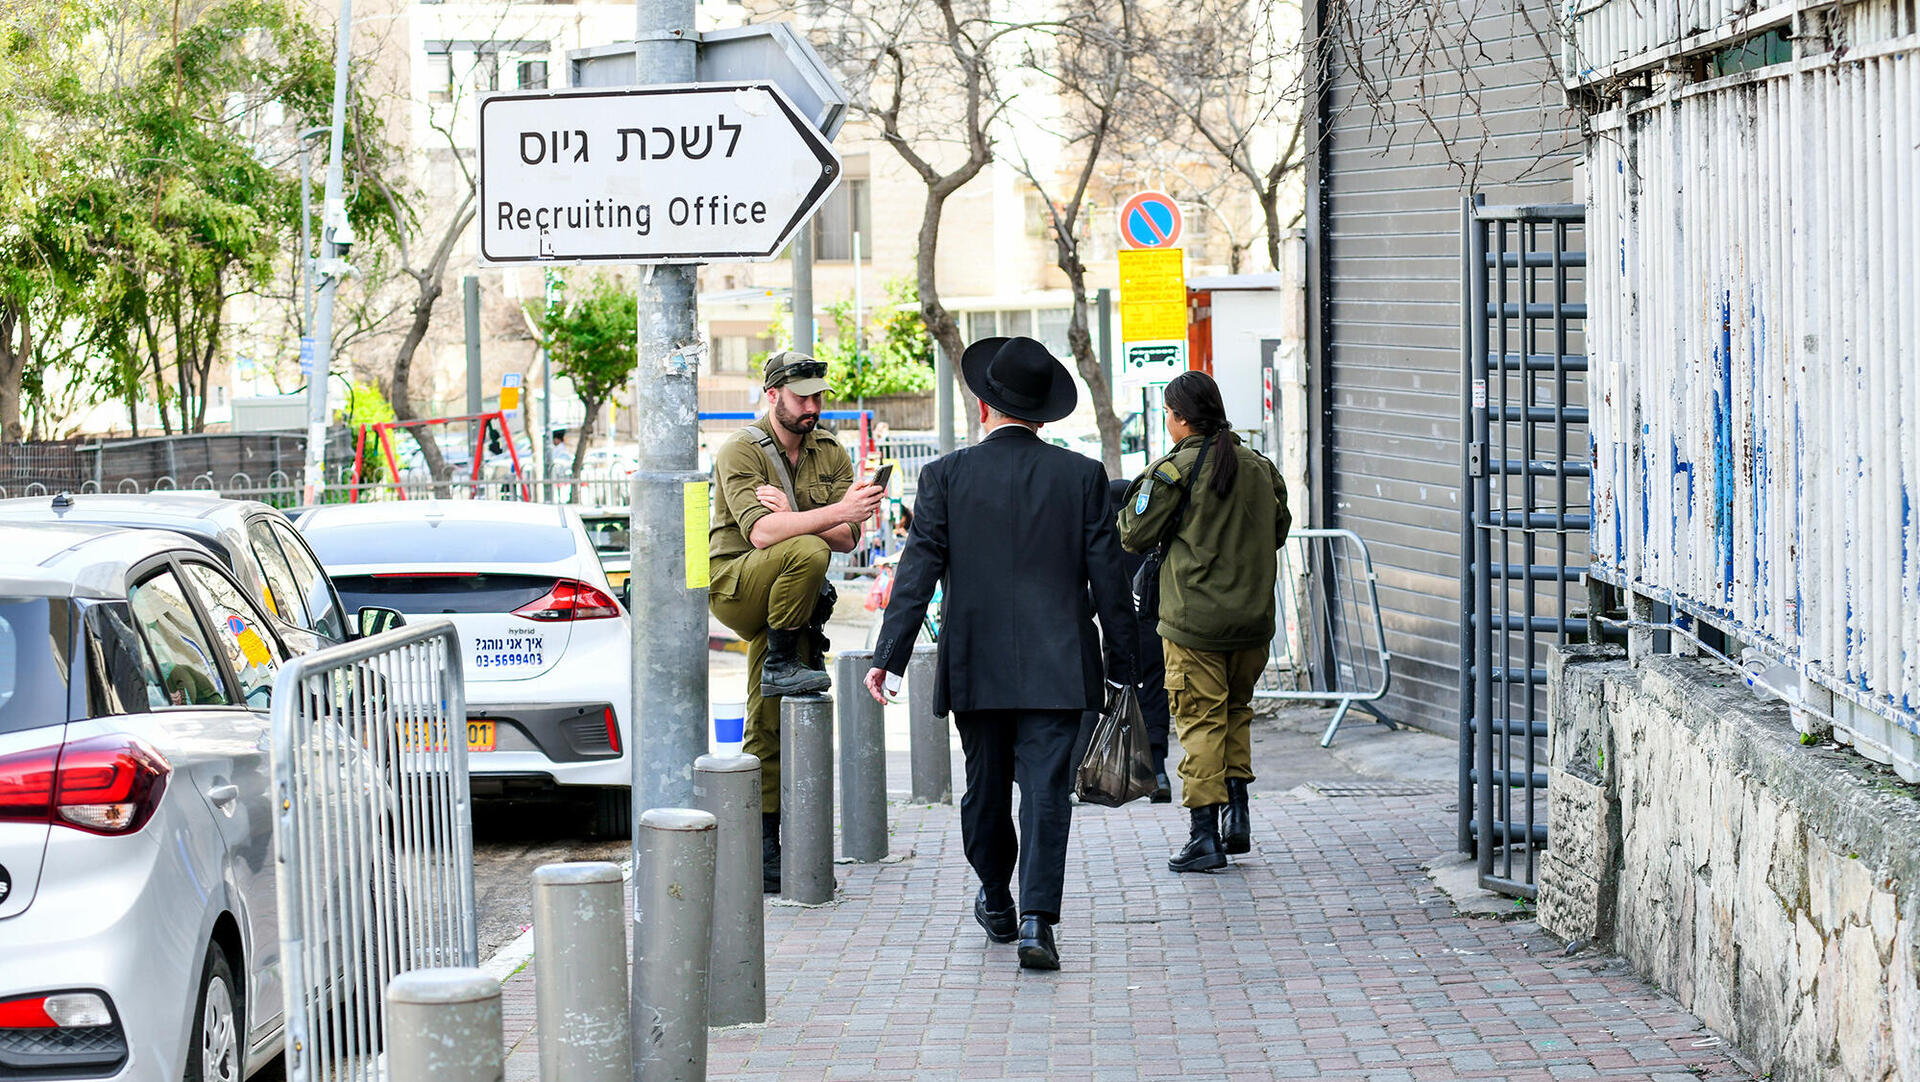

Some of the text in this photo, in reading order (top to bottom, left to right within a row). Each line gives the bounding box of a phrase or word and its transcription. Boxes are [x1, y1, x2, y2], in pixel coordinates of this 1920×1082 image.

[520, 114, 742, 166] לשכת גיוס
[498, 194, 768, 236] Recruiting Office
[475, 637, 543, 652] איך אני נוהג?
[476, 653, 543, 667] 03-5699403
